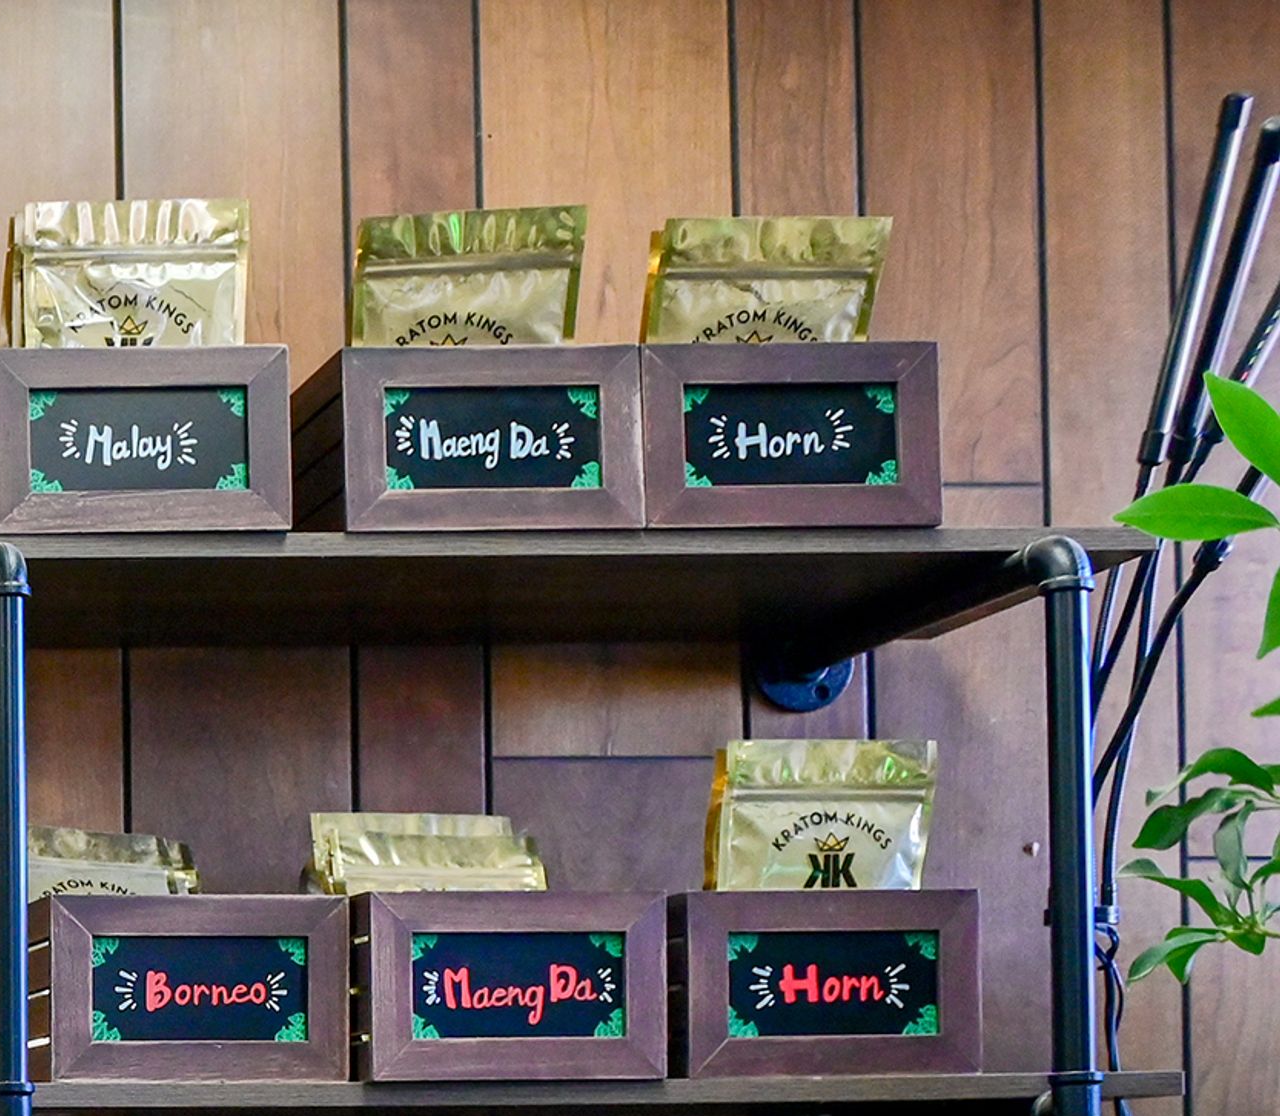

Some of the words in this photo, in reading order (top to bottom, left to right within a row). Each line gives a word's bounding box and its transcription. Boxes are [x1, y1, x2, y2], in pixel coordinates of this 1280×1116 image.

[145, 295, 195, 335] KINGS
[395, 311, 458, 347] RATOM
[464, 311, 514, 346] KINGS
[692, 309, 767, 344] RATOM
[84, 423, 173, 471] Malay
[419, 417, 501, 470] Maeng
[509, 420, 551, 460] Da
[734, 421, 826, 460] Horn
[771, 810, 839, 852] KRATOM
[845, 811, 893, 850] KINGS
[42, 878, 94, 897] RATOM
[145, 969, 267, 1012] Borneo
[443, 966, 545, 1026] Maeng
[549, 963, 599, 1003] Da
[778, 963, 885, 1004] Horn
